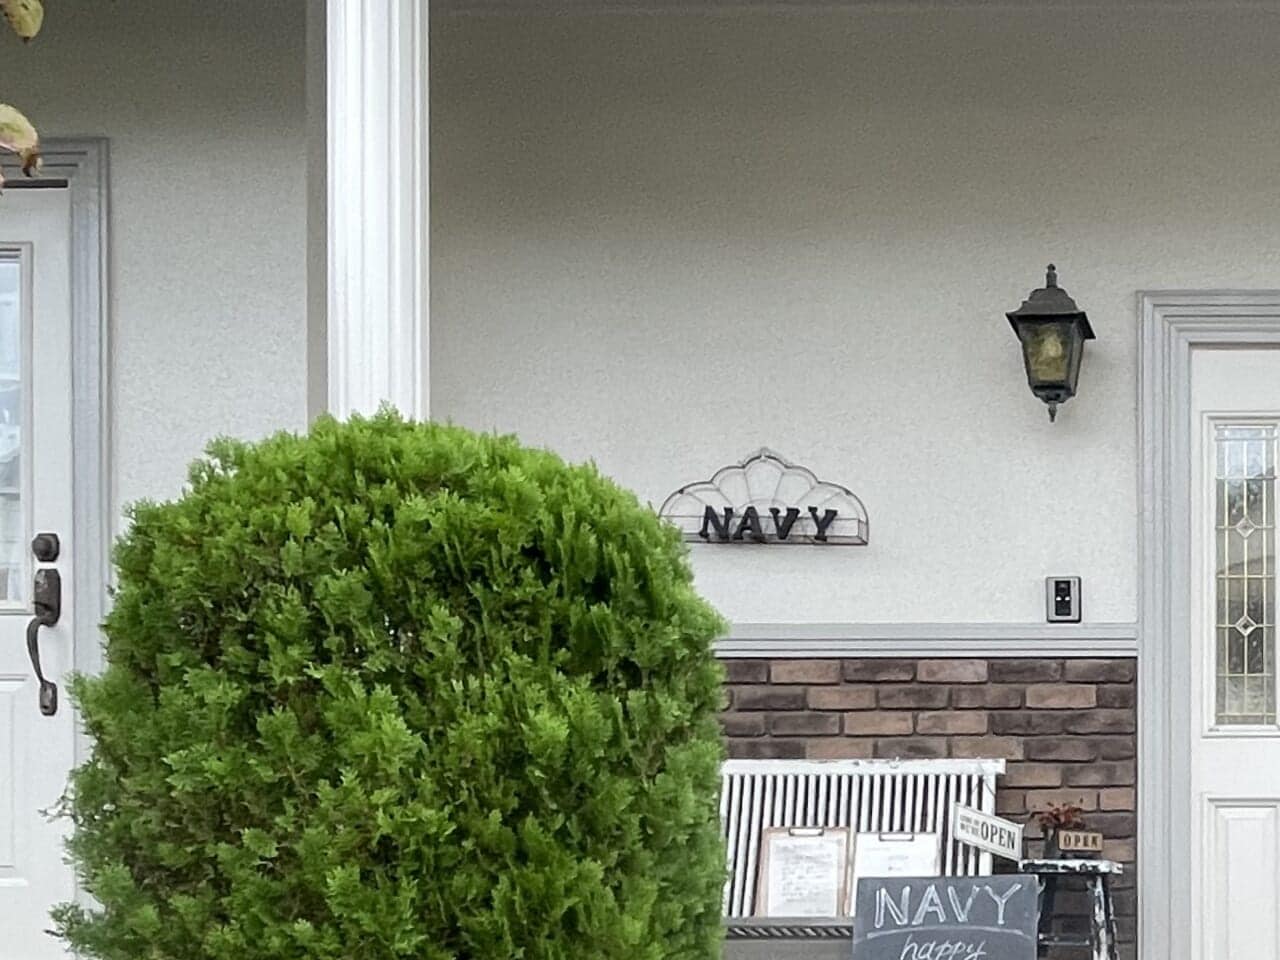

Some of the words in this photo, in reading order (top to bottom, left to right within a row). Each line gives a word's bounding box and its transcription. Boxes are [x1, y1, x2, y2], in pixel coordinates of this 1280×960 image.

[699, 505, 838, 541] NAVY
[981, 821, 1016, 850] OPEN
[1063, 832, 1098, 848] OPEN
[874, 883, 1022, 928] NAVY
